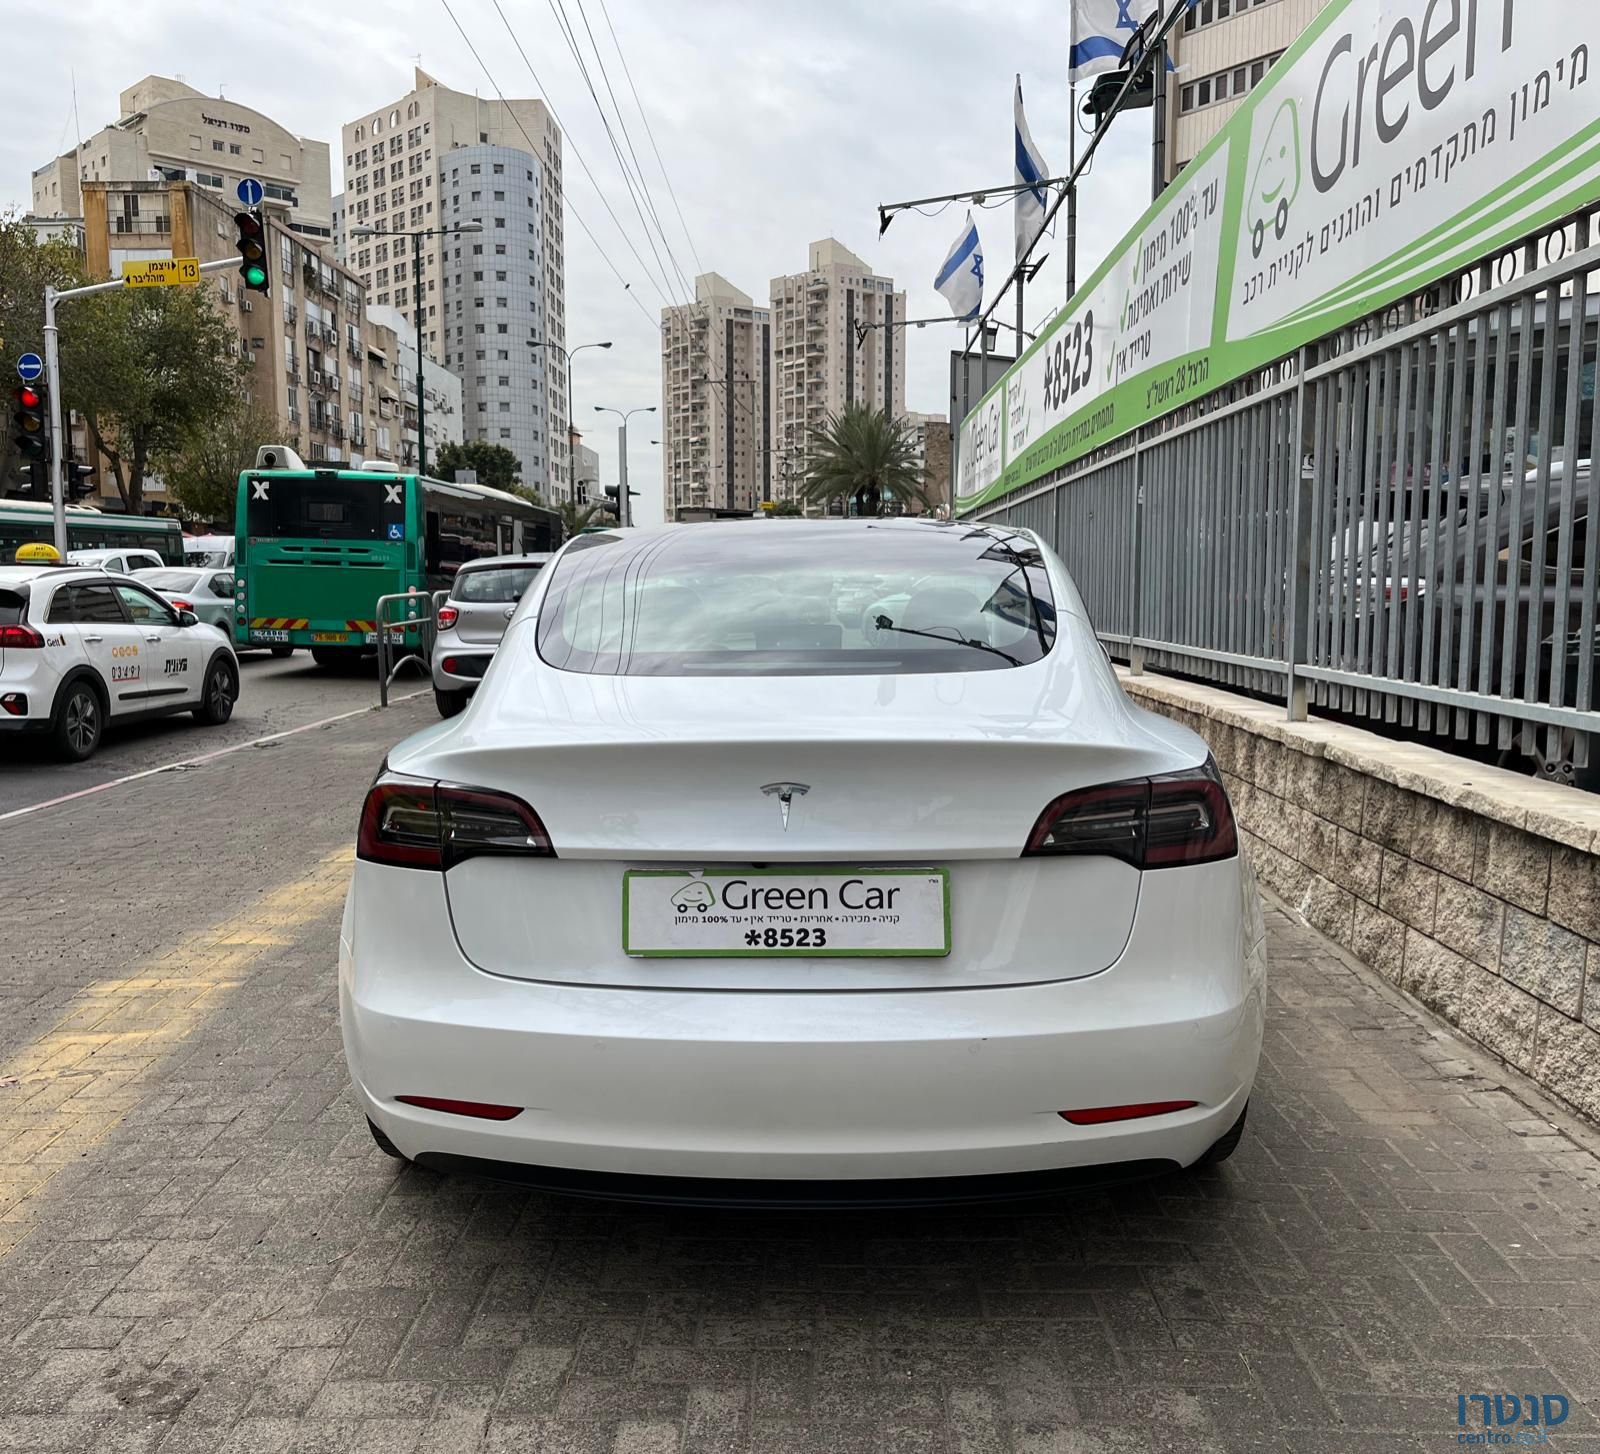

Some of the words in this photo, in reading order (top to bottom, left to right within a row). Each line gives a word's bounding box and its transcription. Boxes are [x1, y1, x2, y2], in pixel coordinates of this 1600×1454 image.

[1509, 43, 1589, 141] מימון
[201, 113, 227, 128] דניאל
[230, 122, 251, 133] מעוז
[1390, 108, 1497, 208] מתקדמים
[1202, 178, 1218, 220] עד
[1170, 195, 1198, 250] 100%
[1320, 187, 1381, 255] והוגנים
[148, 261, 170, 273] ויצמן
[182, 265, 195, 277] 13
[1142, 230, 1166, 285] מימון
[1268, 232, 1315, 284] לקניית
[133, 272, 165, 283] מוהליבר
[1161, 251, 1191, 306] שירות
[1242, 265, 1264, 305] רכב
[1127, 279, 1159, 331] ואמינות
[1130, 330, 1151, 368] טרייד
[1115, 347, 1127, 387] אין
[1176, 365, 1186, 395] 28
[1187, 356, 1208, 388] הרצל
[721, 880, 829, 910] Green
[839, 879, 900, 910] Car
[674, 915, 698, 926] מימון
[701, 915, 728, 923] 100%
[729, 915, 742, 923] עד
[750, 915, 764, 925] אין
[767, 915, 792, 923] טרייד
[800, 915, 833, 923] אחריות
[841, 915, 870, 923] מכירה
[878, 915, 900, 924] קניה
